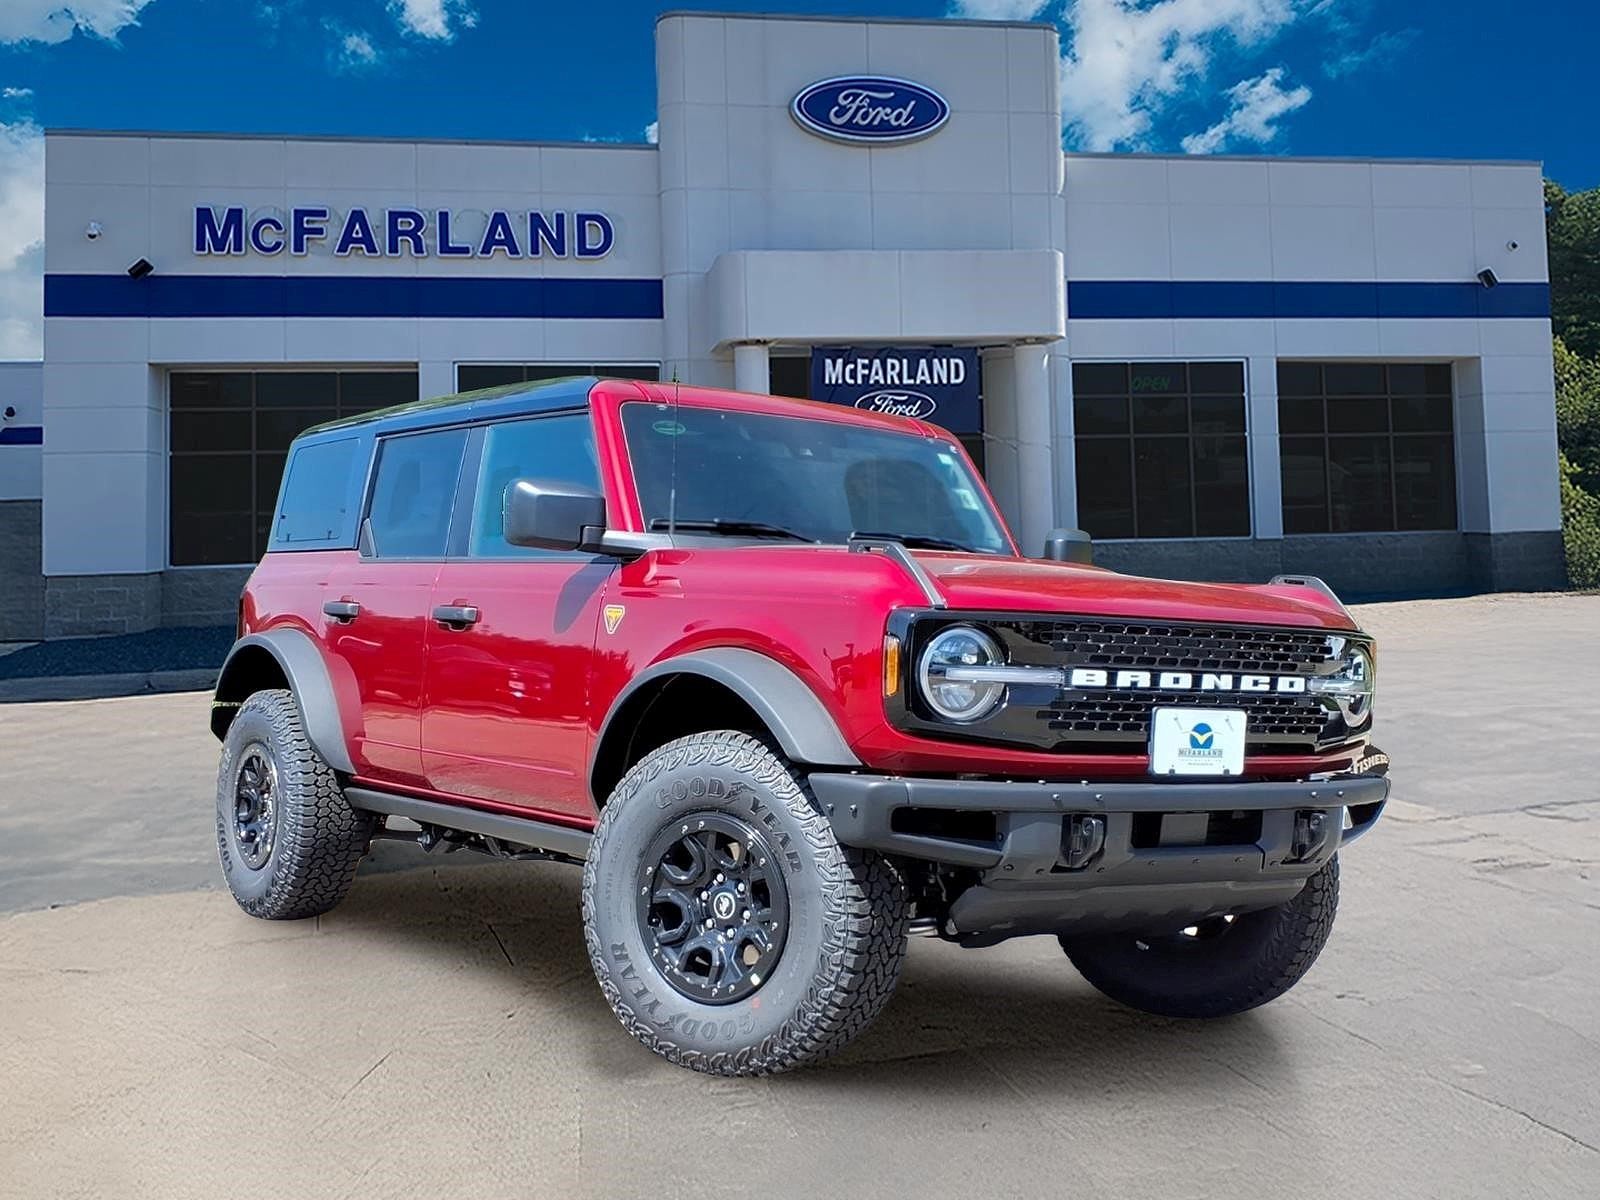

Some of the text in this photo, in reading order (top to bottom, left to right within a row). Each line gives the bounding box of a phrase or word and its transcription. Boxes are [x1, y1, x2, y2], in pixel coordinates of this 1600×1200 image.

[828, 88, 916, 127] Ford
[194, 206, 616, 259] McFARLAND
[823, 357, 966, 386] McFARLAND
[1132, 376, 1171, 391] OPEN
[869, 394, 922, 417] Ford
[1071, 668, 1306, 693] BRONCO
